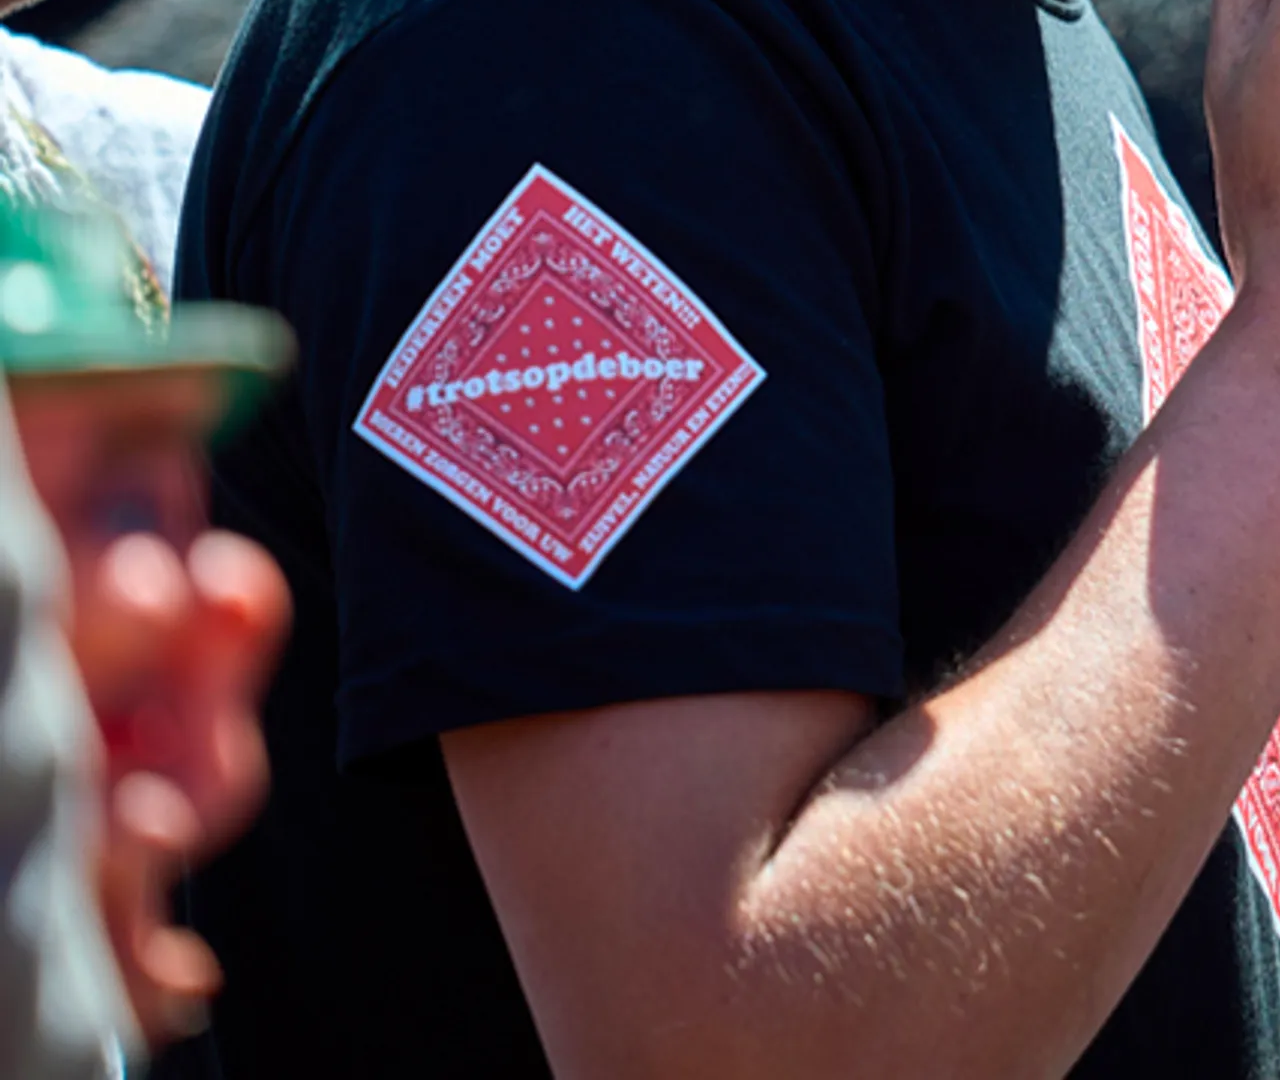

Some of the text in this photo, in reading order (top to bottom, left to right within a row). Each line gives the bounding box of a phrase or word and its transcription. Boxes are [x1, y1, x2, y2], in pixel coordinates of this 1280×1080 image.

[563, 205, 613, 247] HET
[385, 207, 525, 388] IEDEREEN MOET
[405, 351, 704, 412] #trotsopdeboer
[631, 429, 691, 488] NATUUR
[686, 406, 711, 432] EN
[424, 450, 493, 504] ZORGEN
[492, 498, 540, 542] VOOR
[539, 534, 574, 563] UW
